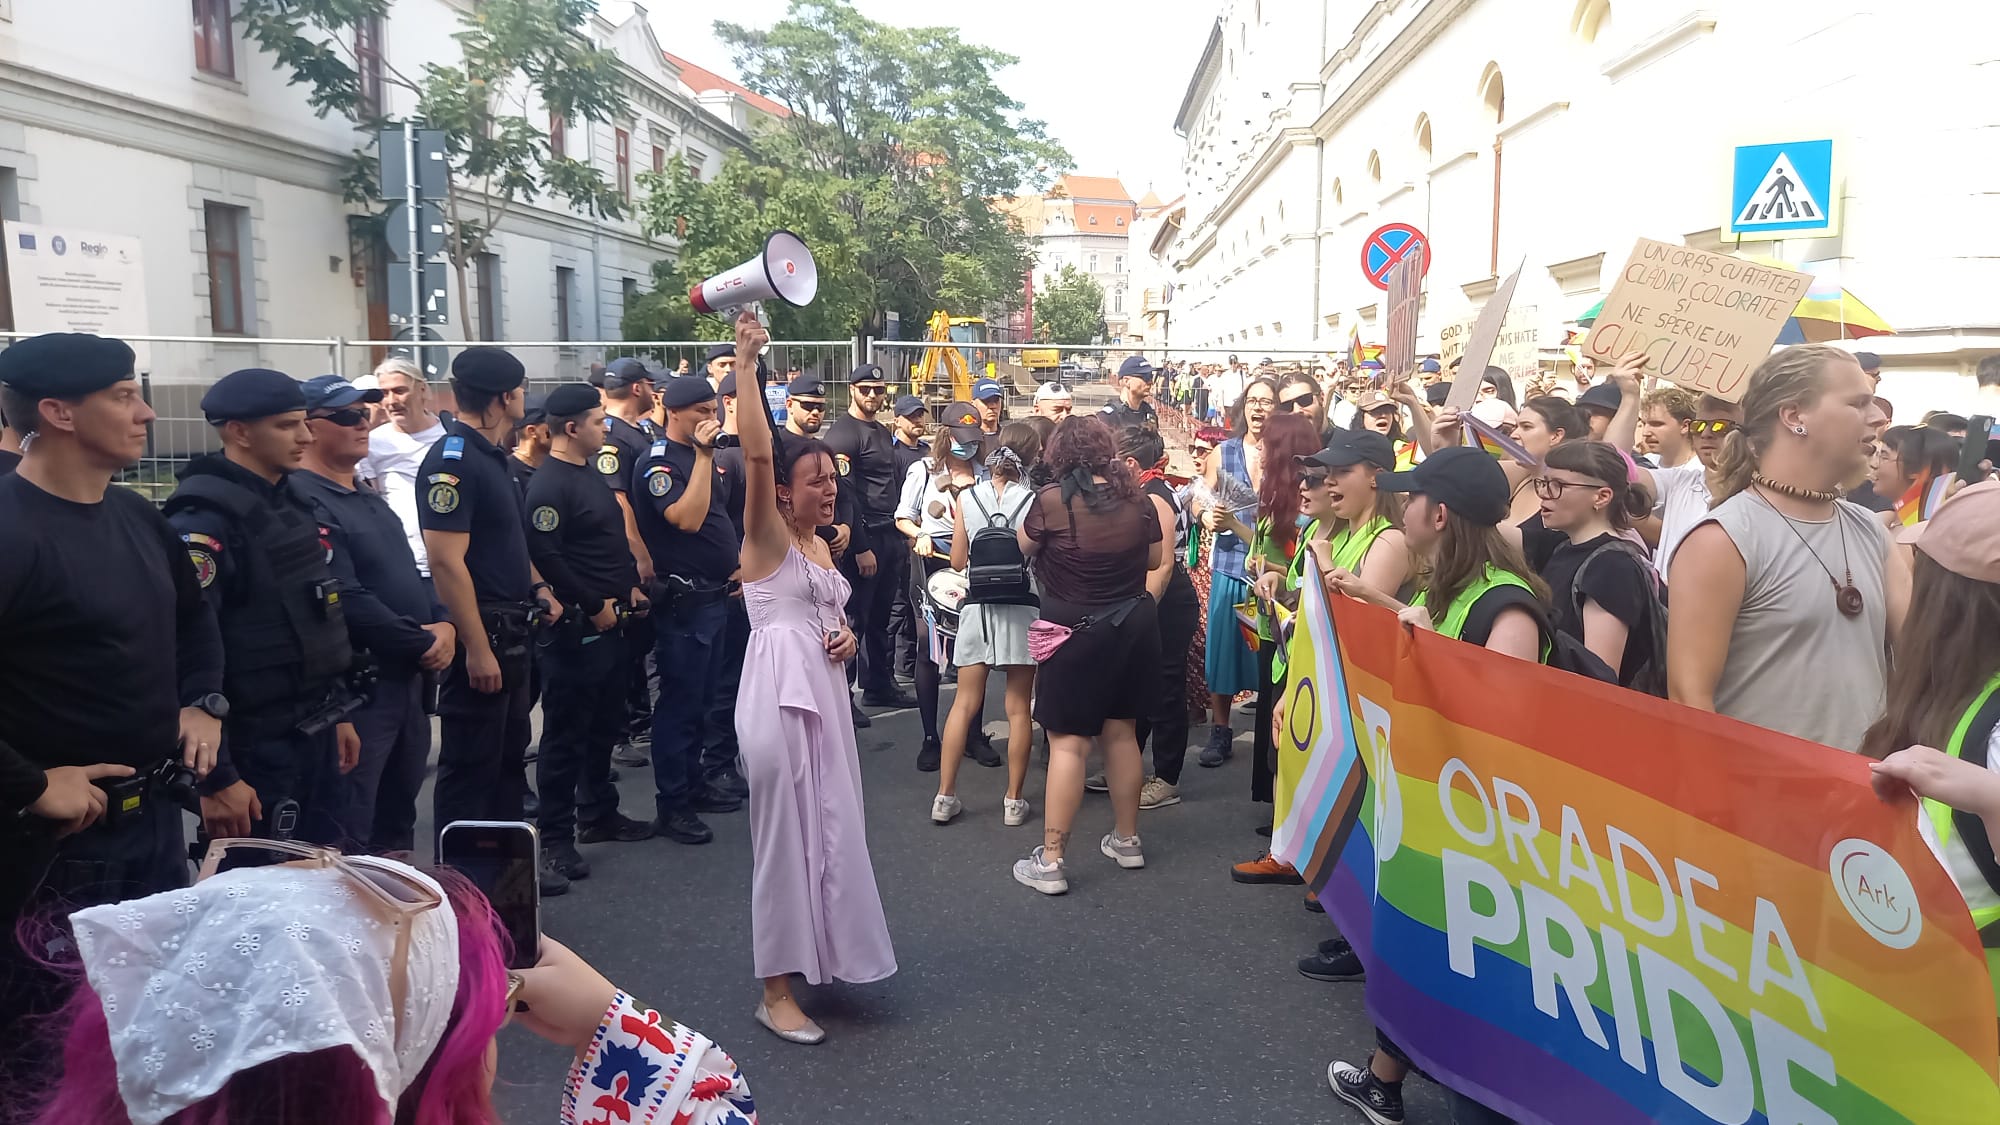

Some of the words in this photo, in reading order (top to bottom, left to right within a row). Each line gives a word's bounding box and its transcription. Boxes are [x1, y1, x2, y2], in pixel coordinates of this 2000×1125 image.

[81, 241, 108, 256] Regio
[1644, 243, 1670, 261] UN
[1690, 281, 1788, 320] COLORATE
[1440, 324, 1463, 341] GOD
[1514, 328, 1538, 345] HATE
[1621, 302, 1651, 324] NE
[1655, 313, 1714, 342] SPERIE
[1714, 331, 1742, 349] UN
[1438, 757, 1827, 1033] ORADEA
[1858, 874, 1898, 912] Ark
[1441, 848, 1839, 1125] PRIDE
